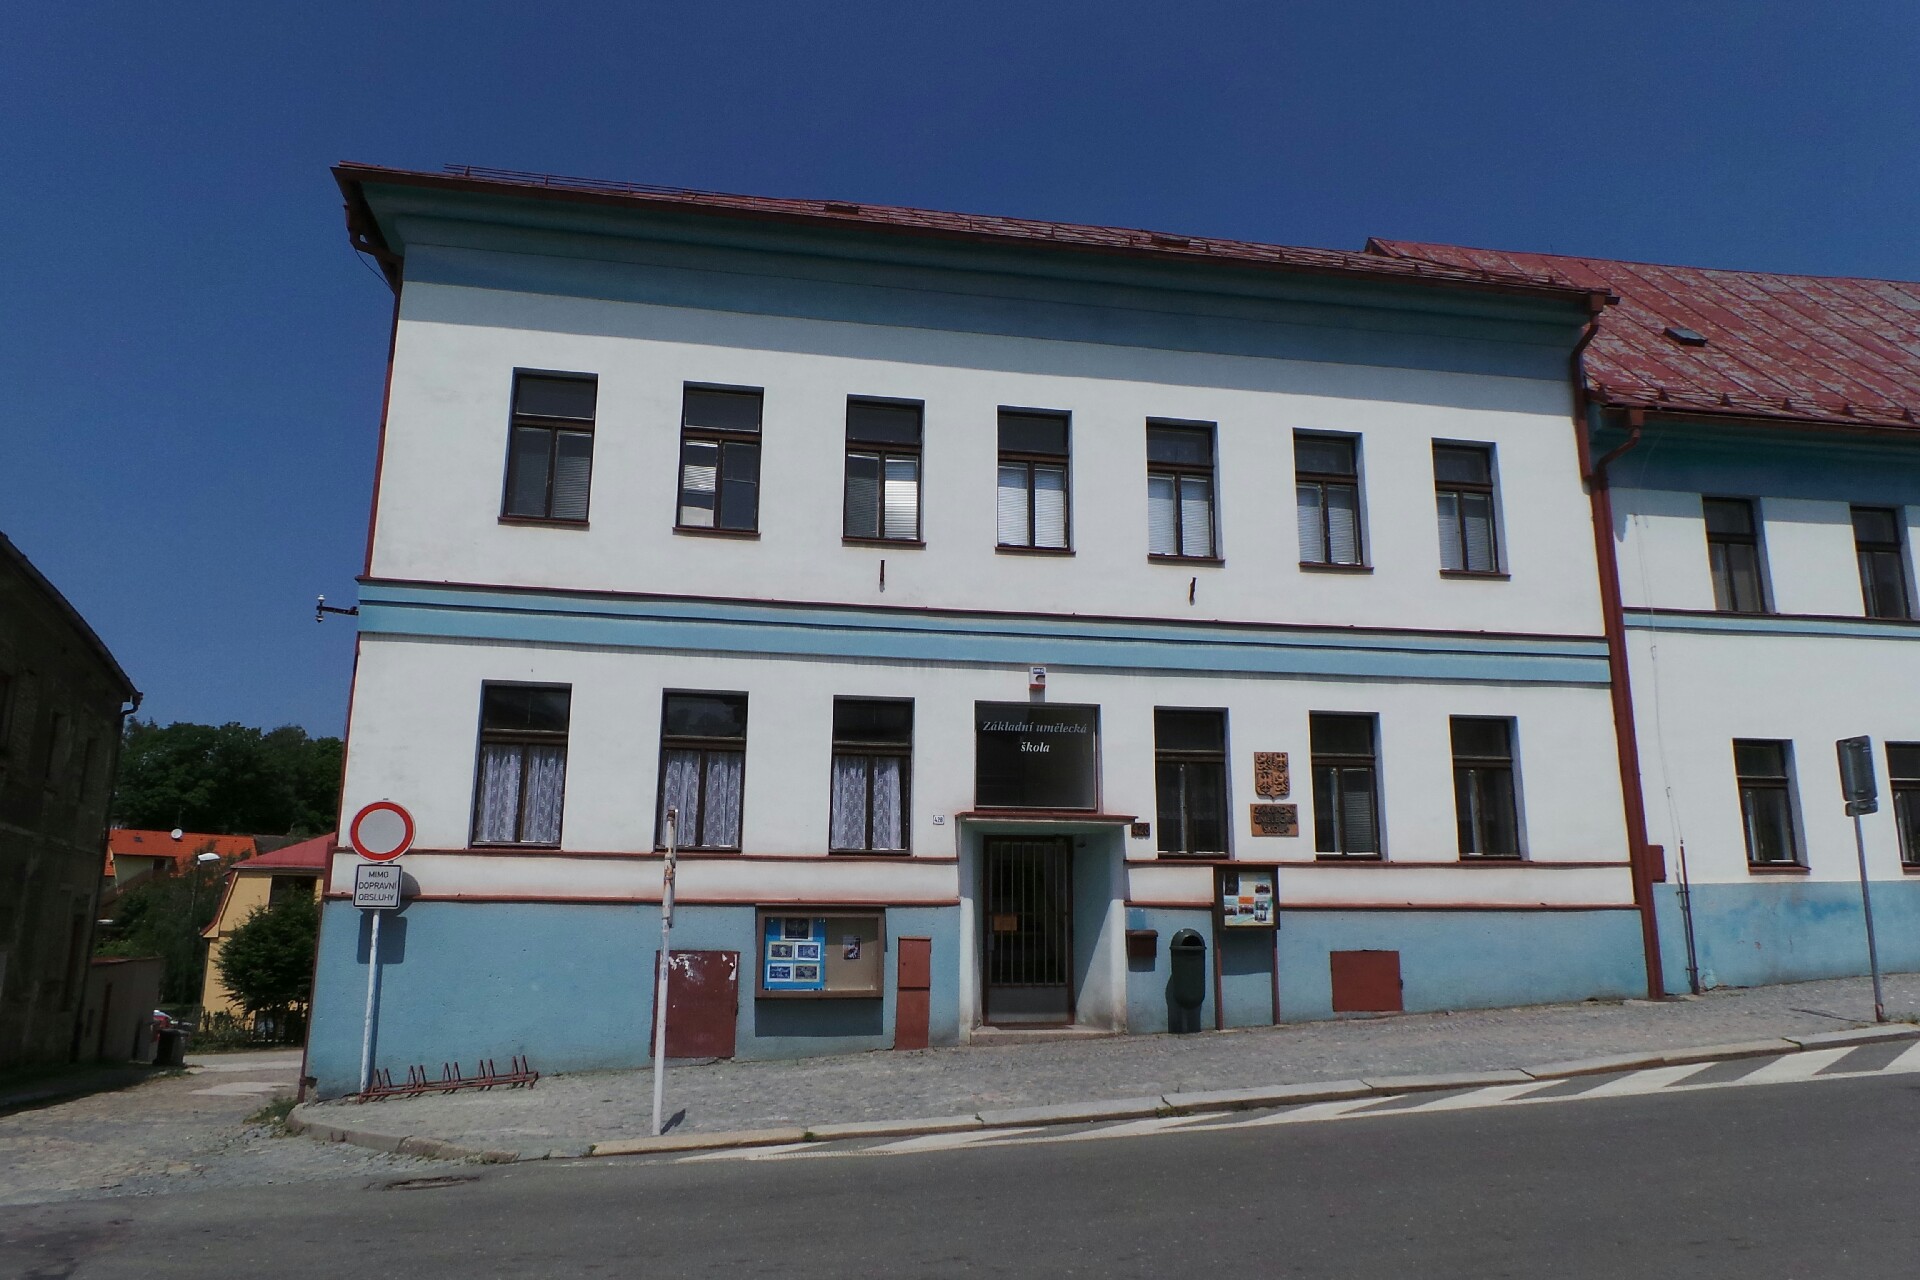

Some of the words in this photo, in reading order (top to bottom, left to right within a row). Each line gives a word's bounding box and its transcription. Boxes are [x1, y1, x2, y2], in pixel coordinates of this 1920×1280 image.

[983, 721, 1034, 732] Základní
[1036, 723, 1087, 733] umělecká
[1020, 742, 1050, 753] škola
[358, 881, 398, 890] DOPRAVNÍ
[358, 893, 395, 901] OBSLUHY
